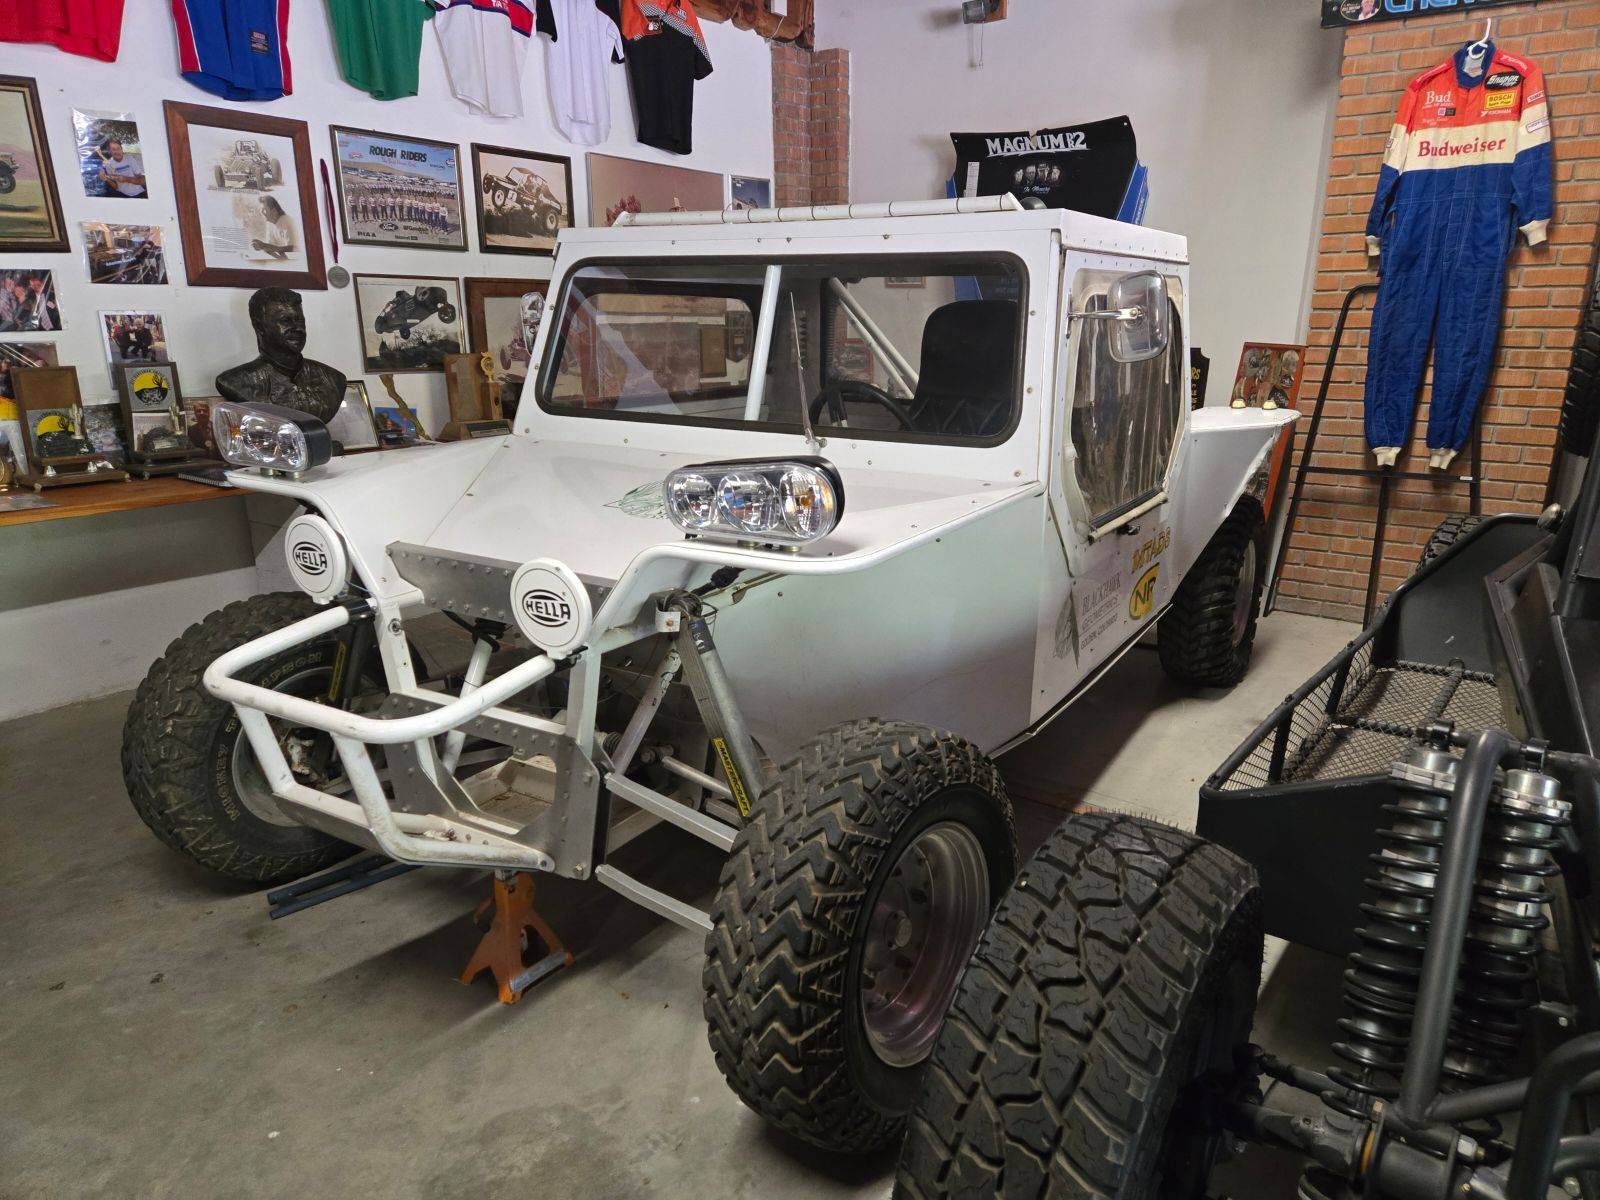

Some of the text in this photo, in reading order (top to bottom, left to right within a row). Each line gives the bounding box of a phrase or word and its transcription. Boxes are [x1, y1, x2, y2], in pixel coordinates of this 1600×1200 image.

[1425, 91, 1452, 104] Bud
[1488, 94, 1513, 102] BOSCH
[369, 145, 397, 159] ROUGH
[400, 150, 428, 163] RIDERS
[1417, 137, 1506, 158] Budweiser
[294, 550, 328, 569] HELLA
[525, 601, 571, 620] HELLA
[717, 743, 751, 813] MASTERCRAFT
